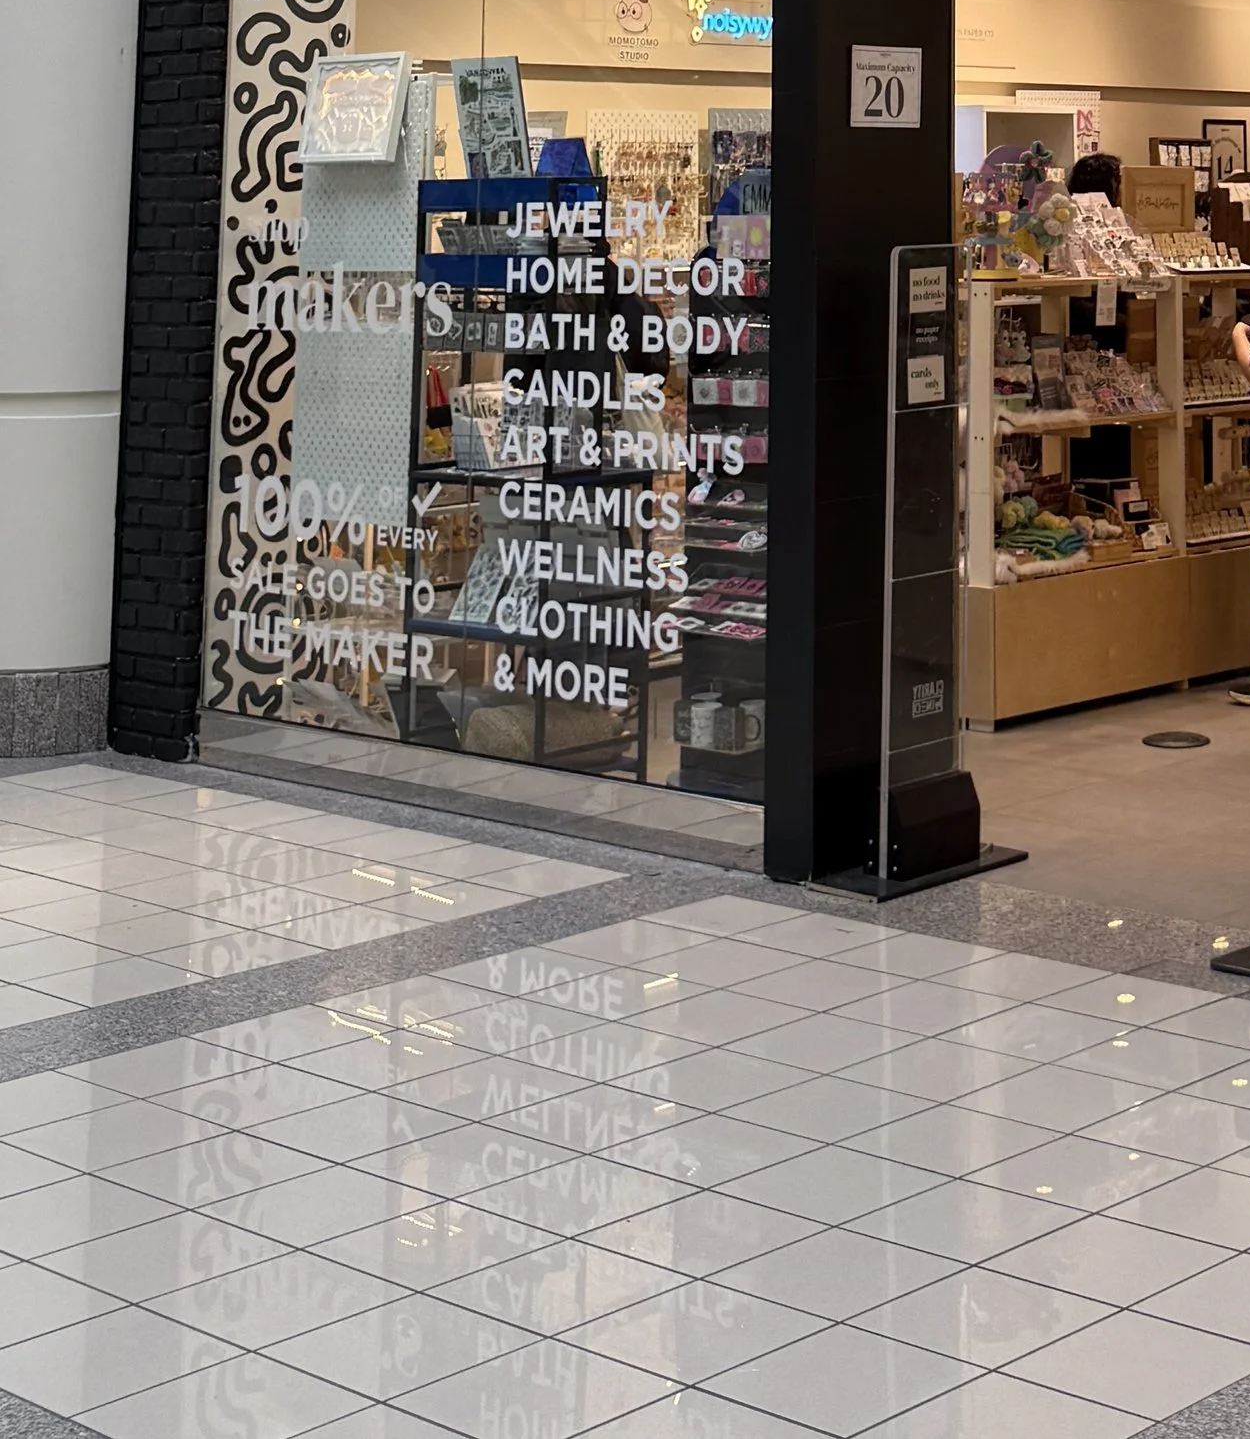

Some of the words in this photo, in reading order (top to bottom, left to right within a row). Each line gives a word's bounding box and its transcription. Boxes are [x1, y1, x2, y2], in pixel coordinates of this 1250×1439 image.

[608, 36, 659, 48] MOMOTOMO
[619, 51, 649, 60] STUDIO
[887, 63, 915, 75] Capacity
[864, 75, 904, 118] 20
[506, 200, 673, 239] JEWELRY
[506, 257, 605, 294] HOME
[617, 257, 745, 296] DECOR
[912, 279, 922, 287] no
[923, 275, 940, 287] food
[912, 294, 922, 302] no
[923, 289, 945, 301] drinks
[248, 261, 454, 337] makers
[505, 313, 596, 351] BATH
[607, 314, 629, 352] &
[642, 316, 748, 356] BODY
[503, 367, 666, 411] CANDLES
[911, 367, 932, 379] cards
[925, 378, 939, 390] only
[500, 425, 569, 464] ART
[579, 428, 601, 466] &
[614, 430, 744, 476] PRINTS
[235, 474, 366, 546] 100%
[378, 485, 407, 509] OF
[499, 481, 681, 531] CERAMICS
[377, 525, 439, 551] EVERY
[229, 557, 298, 596] SALE
[307, 566, 384, 607] GOES
[394, 576, 435, 613] TO
[498, 538, 688, 593] WELLNESS
[228, 610, 292, 658] THE
[304, 621, 433, 680] MAKER
[496, 596, 679, 652] CLOTHING
[494, 653, 515, 693] &
[527, 657, 629, 707] MORE
